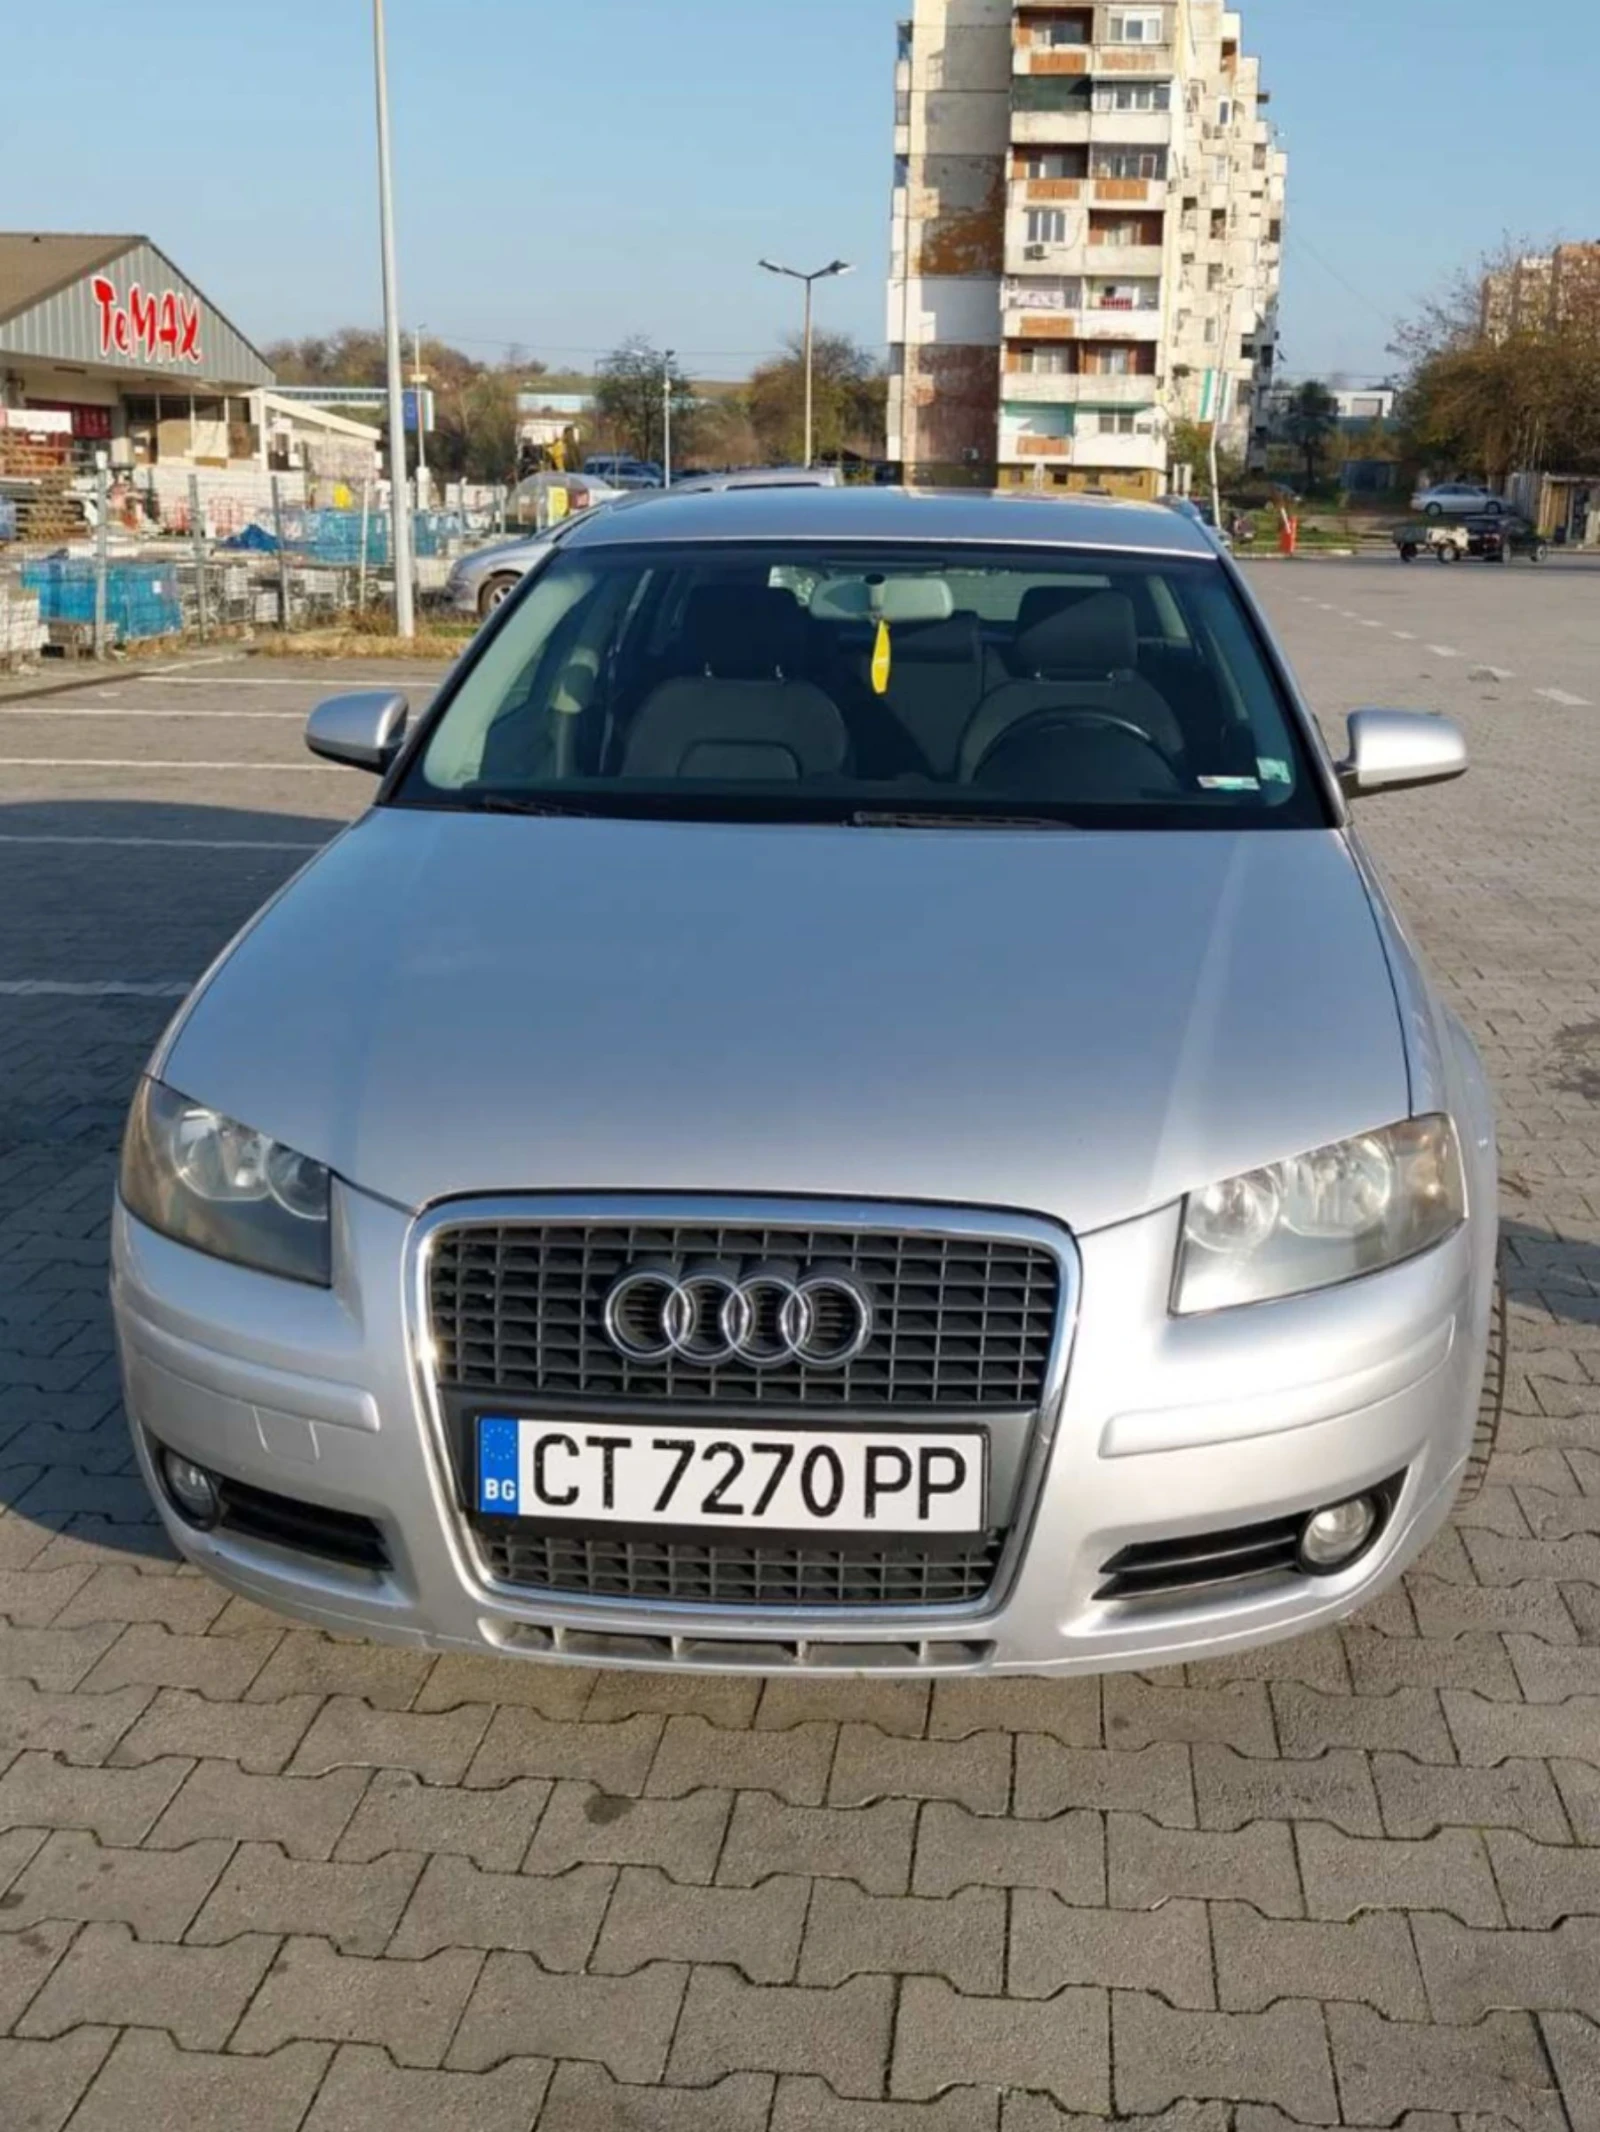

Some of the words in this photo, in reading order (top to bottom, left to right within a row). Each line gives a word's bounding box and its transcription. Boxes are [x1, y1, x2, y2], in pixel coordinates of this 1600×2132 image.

[93, 277, 201, 363] TeMAX
[485, 1478, 516, 1500] BG
[533, 1433, 632, 1509] CT
[652, 1439, 845, 1518] 7270
[865, 1446, 967, 1520] PP
